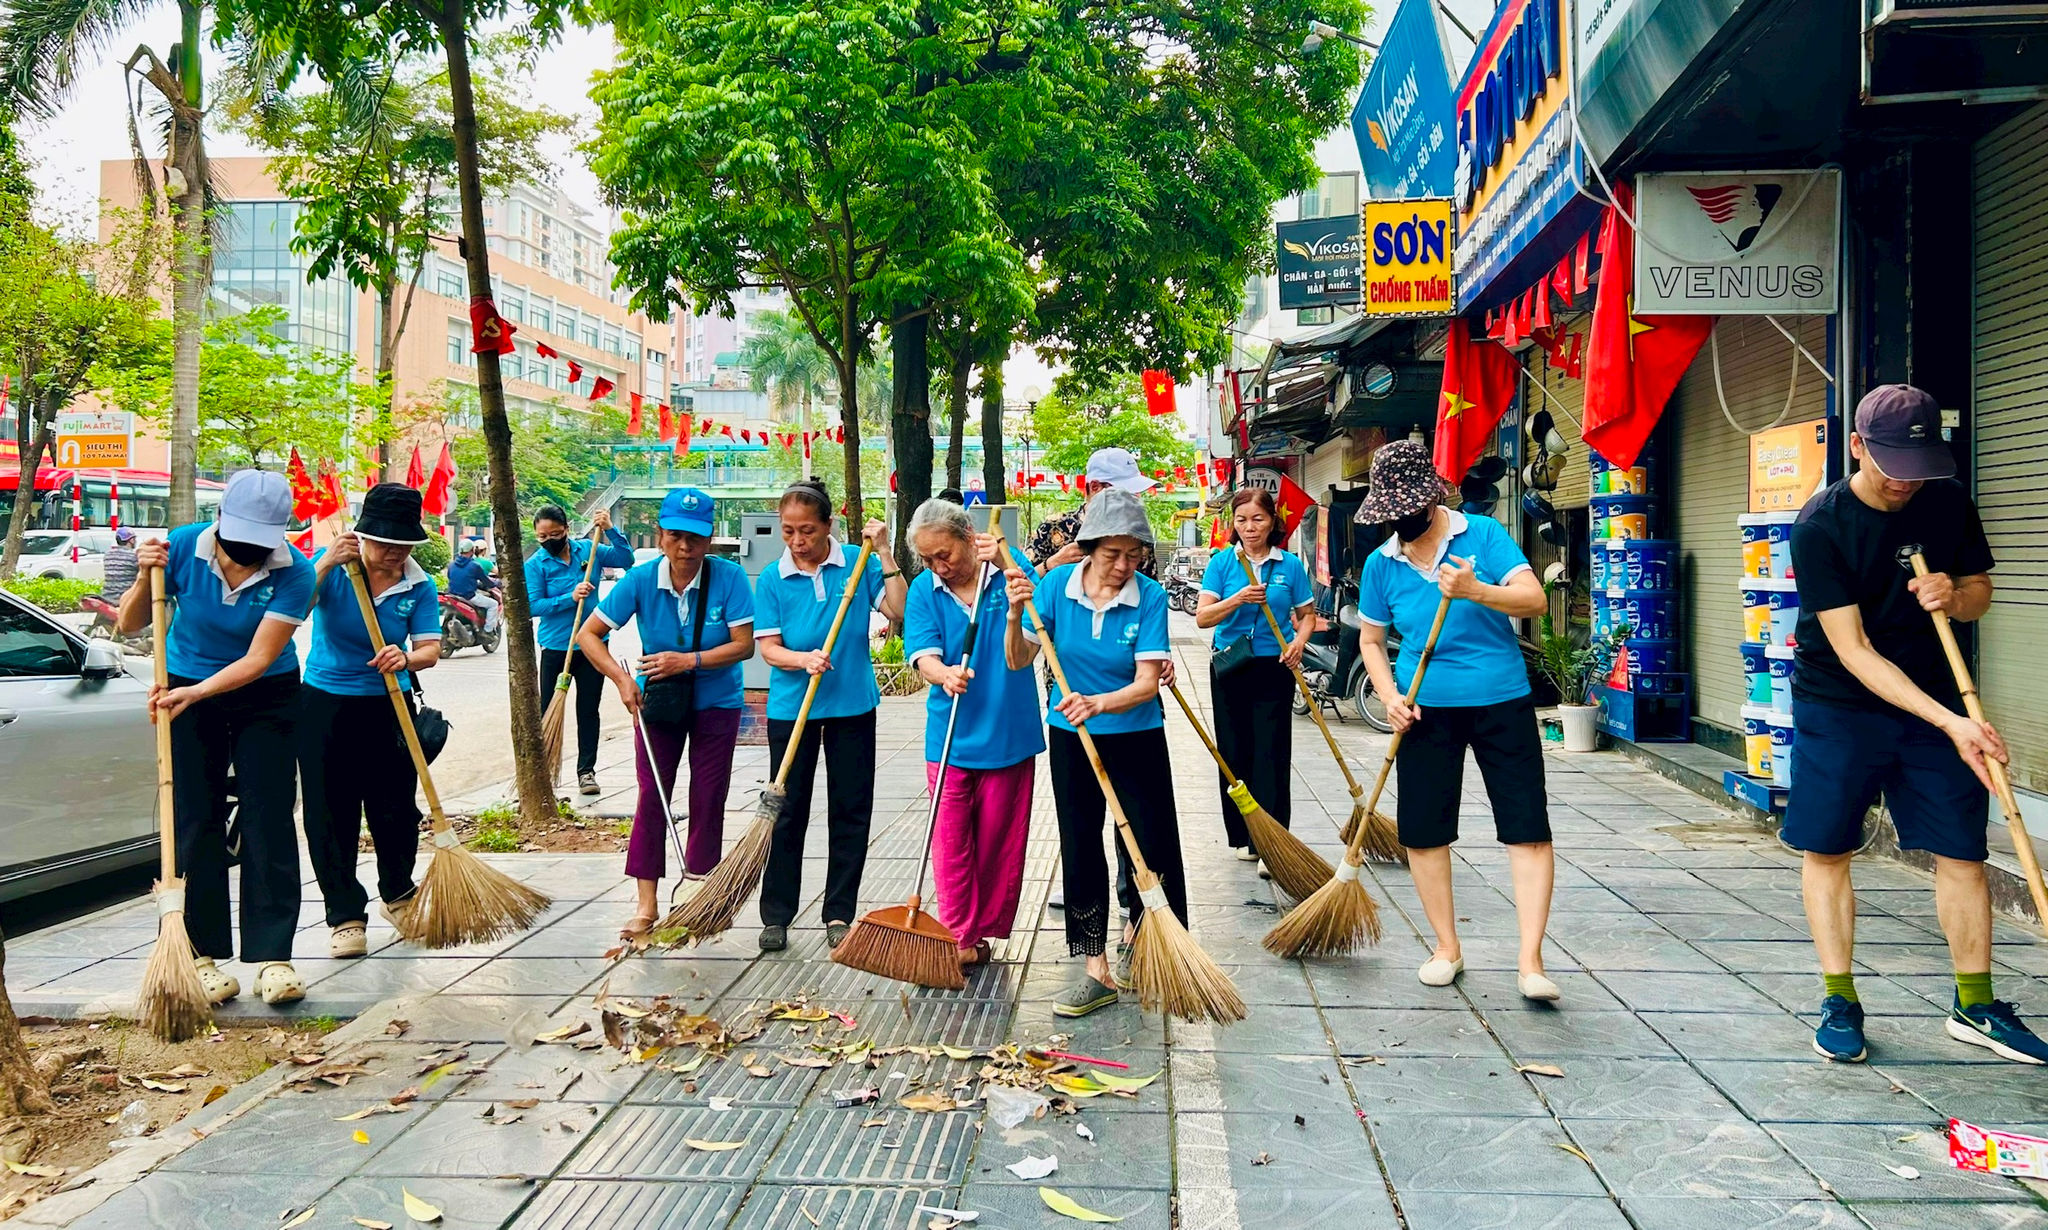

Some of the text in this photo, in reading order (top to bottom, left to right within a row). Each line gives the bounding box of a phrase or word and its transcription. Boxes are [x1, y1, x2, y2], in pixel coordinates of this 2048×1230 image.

[1377, 64, 1419, 147] VIKOSAN
[1304, 232, 1360, 256] VIKOSA
[1373, 213, 1446, 266] SƠN
[1314, 270, 1327, 280] GA
[1333, 264, 1348, 278] GỐI
[1650, 265, 1823, 298] VENUS
[1370, 274, 1412, 303] CHỐNG
[1414, 273, 1449, 302] THẤM
